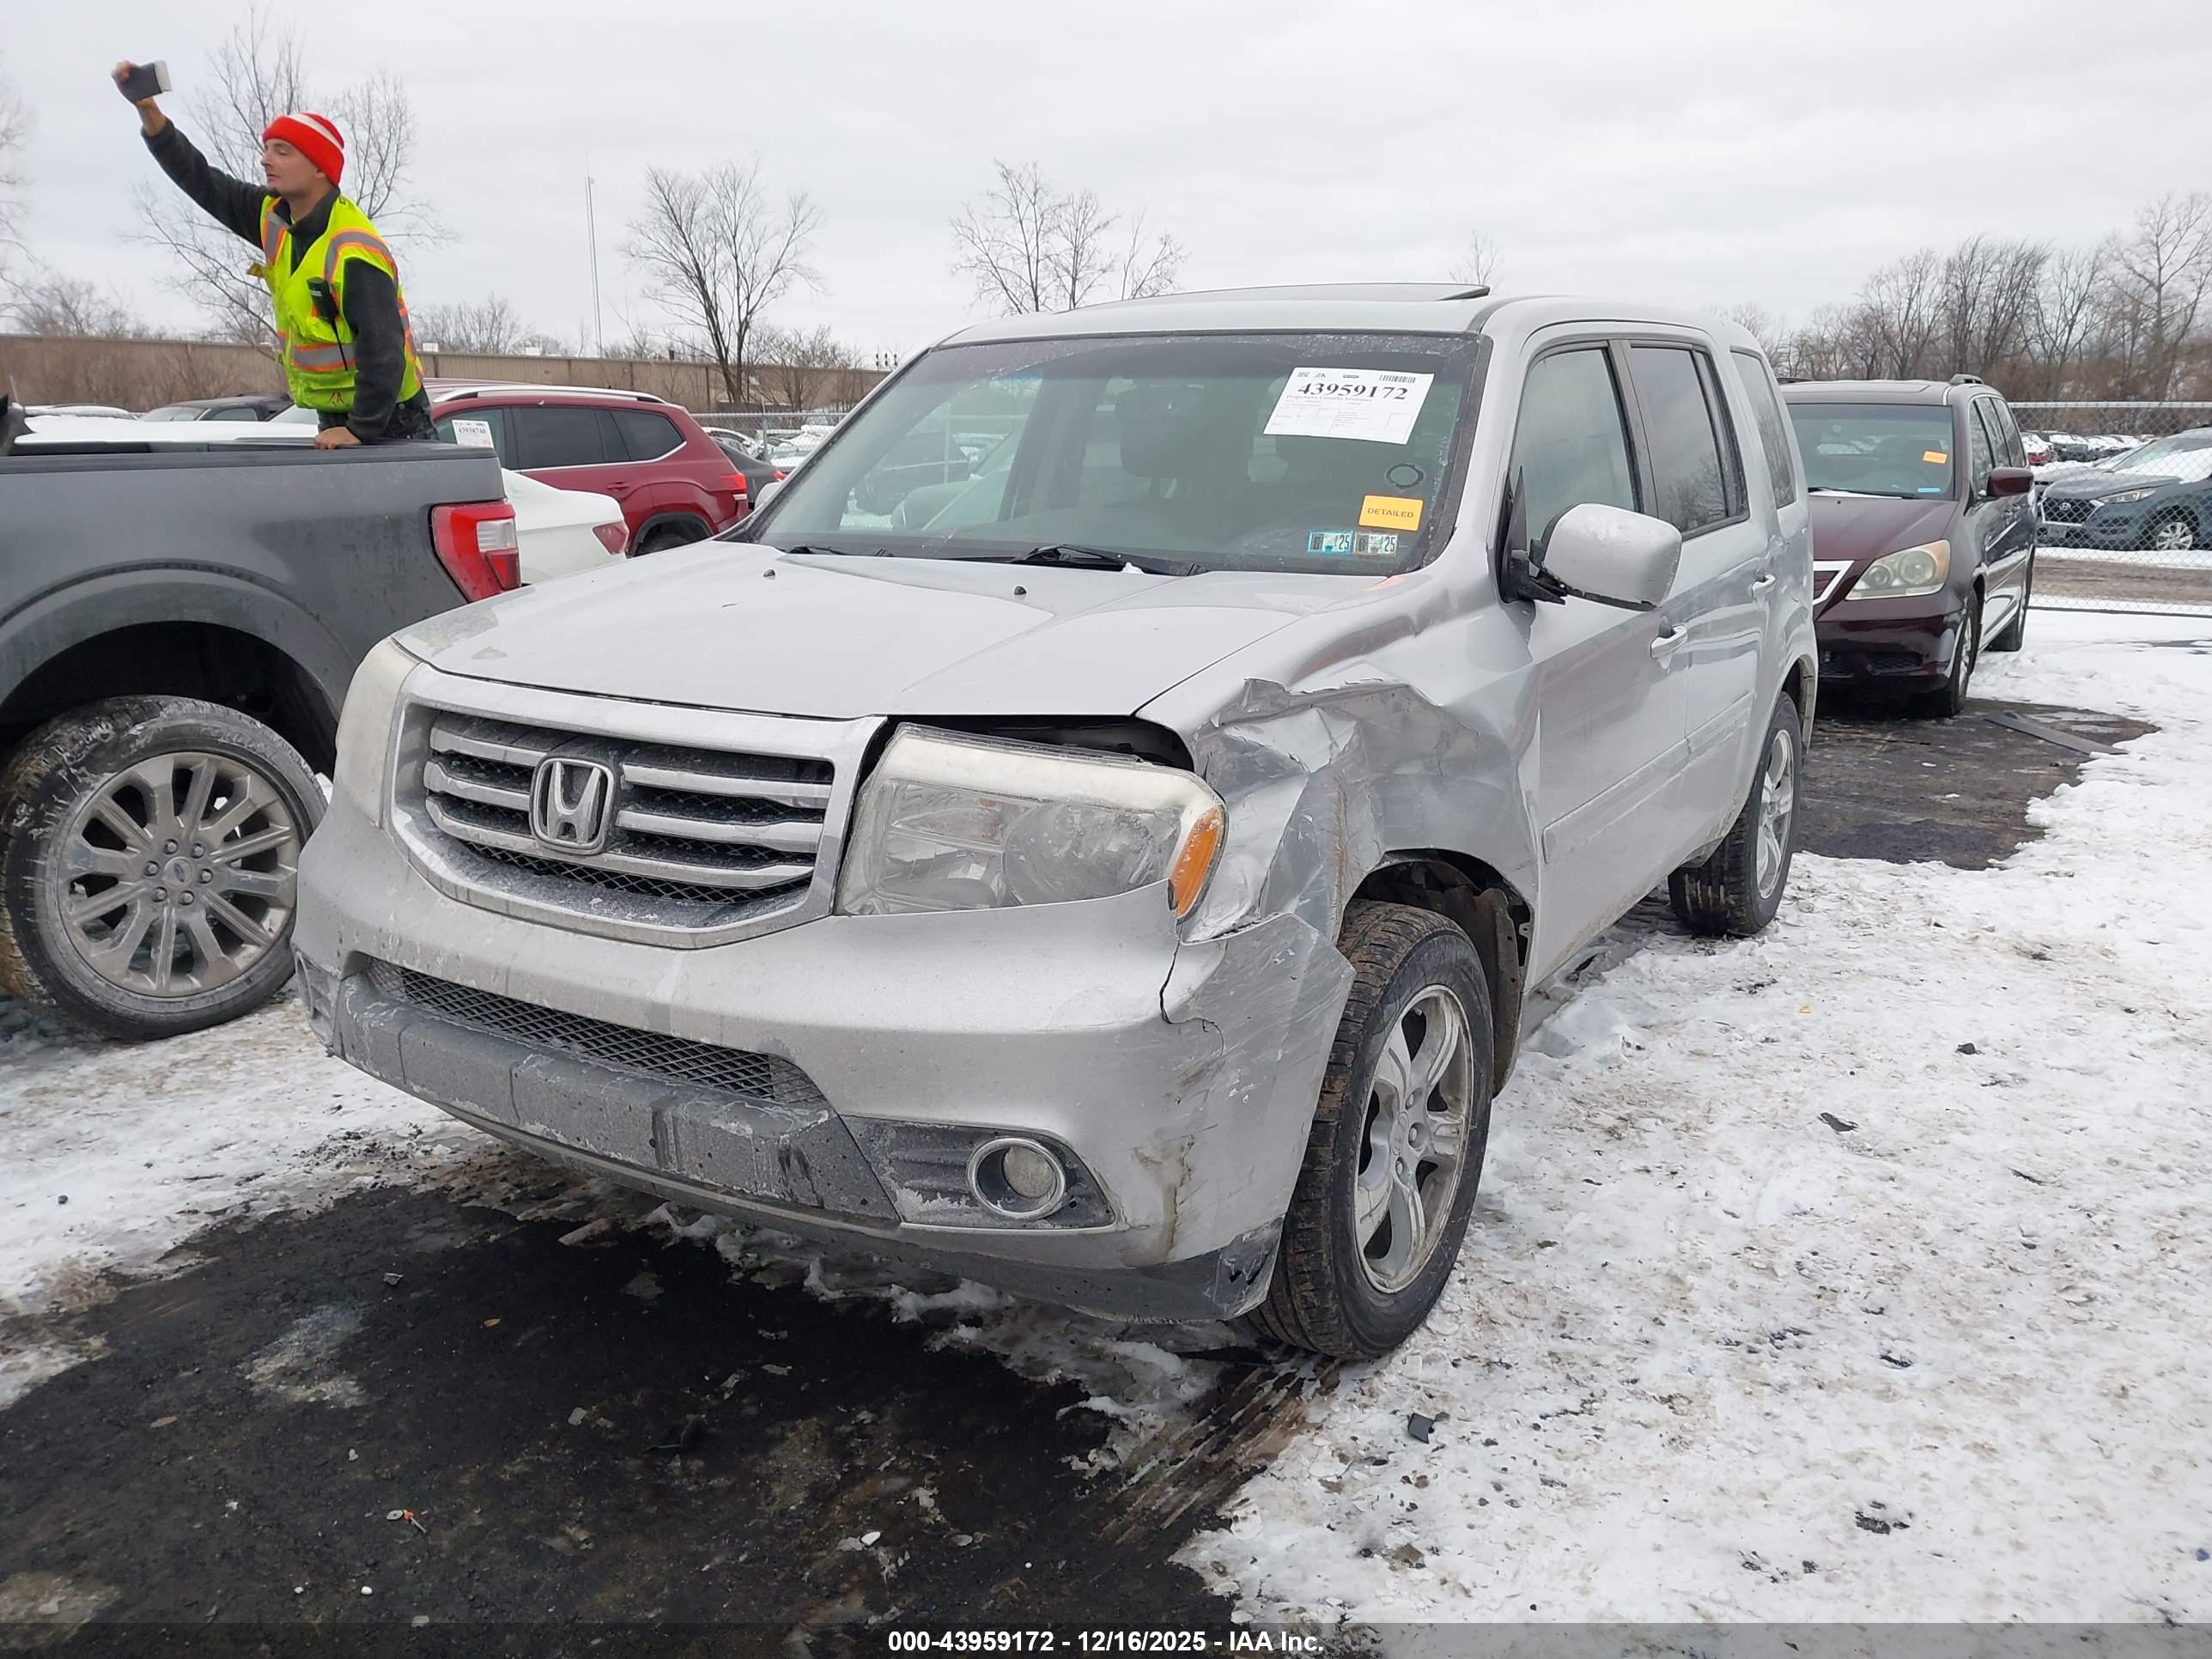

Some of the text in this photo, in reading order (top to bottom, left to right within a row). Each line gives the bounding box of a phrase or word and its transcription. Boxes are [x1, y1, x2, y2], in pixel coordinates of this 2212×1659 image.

[1297, 382, 1408, 400] 43959172
[1367, 507, 1414, 519] DETAILED
[1339, 534, 1350, 550] 25
[1384, 536, 1396, 552] 25
